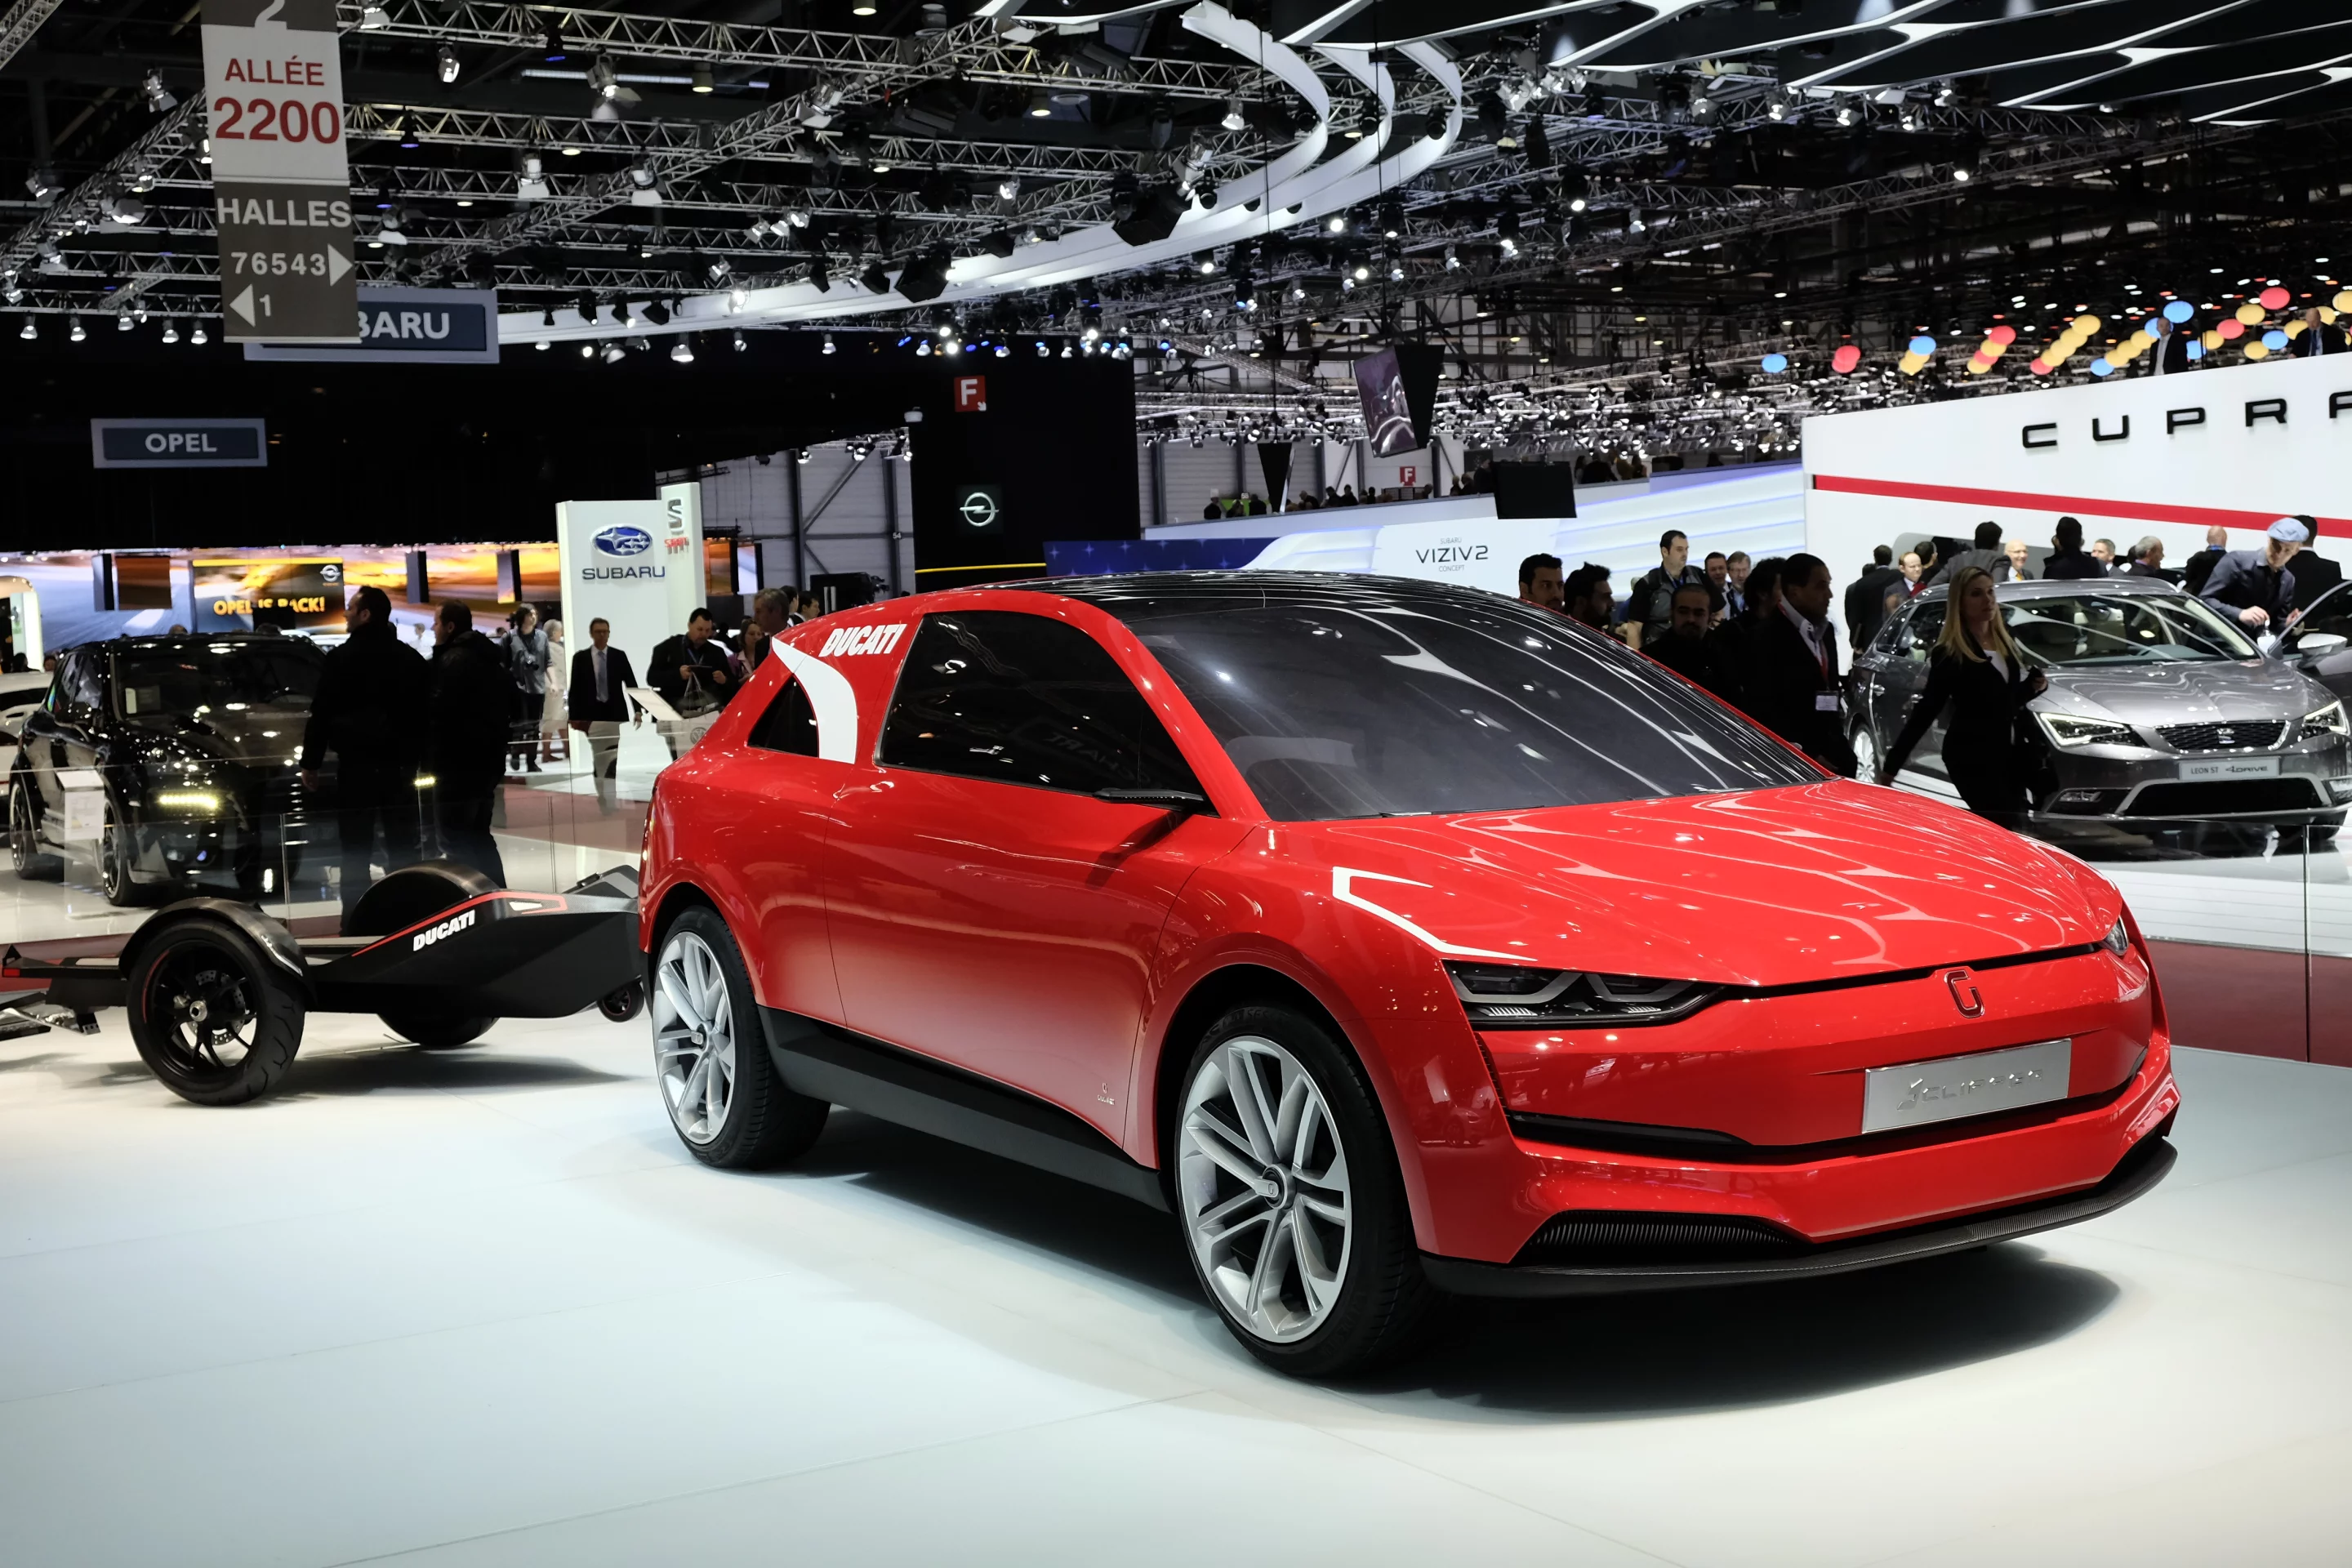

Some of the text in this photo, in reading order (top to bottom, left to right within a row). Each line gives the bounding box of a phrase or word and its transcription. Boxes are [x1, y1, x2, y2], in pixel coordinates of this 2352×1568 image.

[225, 56, 325, 86] ALLÉE
[213, 96, 341, 145] 2200
[216, 198, 352, 229] HALLES
[230, 252, 327, 277] 76543
[258, 294, 272, 318] 1
[357, 310, 451, 340] BARU
[960, 378, 978, 406] F
[145, 433, 218, 453] OPEL
[1404, 467, 1414, 483] F
[1440, 537, 1462, 545] SUBARU
[581, 566, 666, 581] SUBARU
[213, 599, 254, 616] OPEL
[817, 623, 907, 657] DUCATI
[2225, 765, 2268, 773] 4DRIVE
[413, 909, 475, 951] DUCATI
